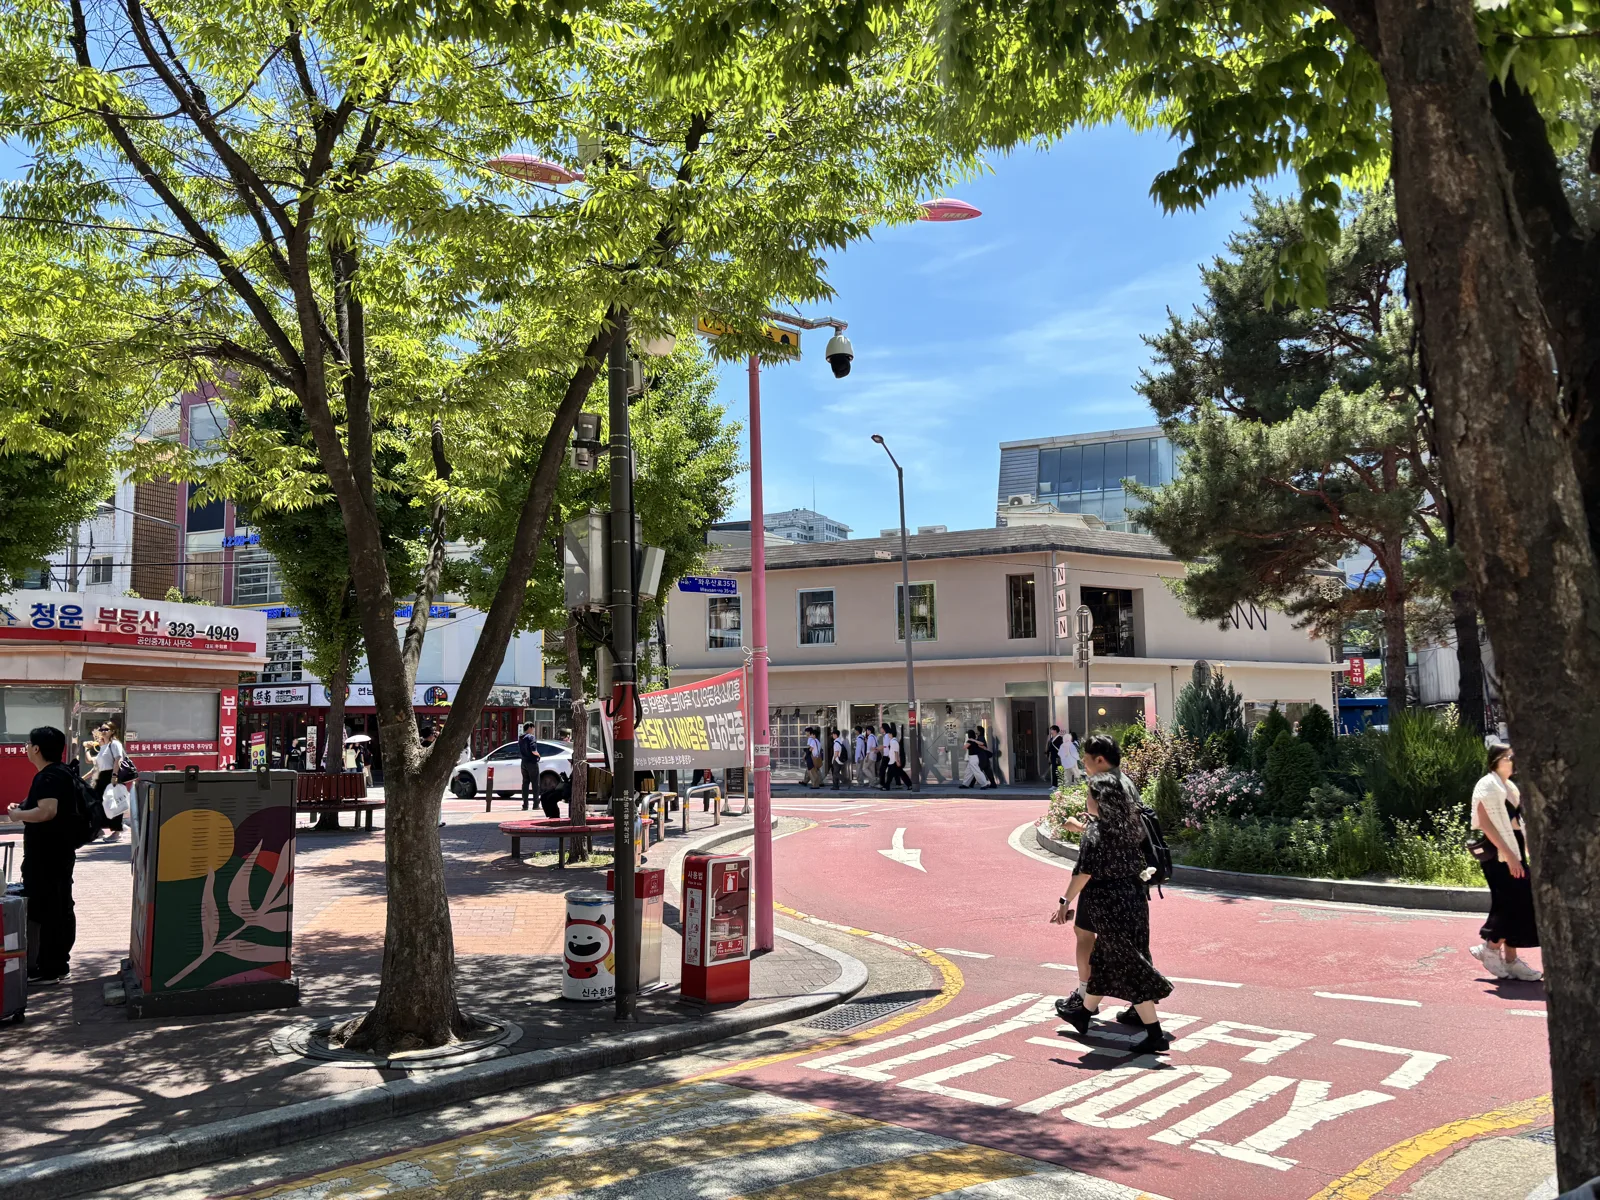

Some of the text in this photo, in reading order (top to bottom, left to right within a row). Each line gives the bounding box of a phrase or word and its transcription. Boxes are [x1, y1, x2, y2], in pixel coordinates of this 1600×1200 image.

[698, 578, 736, 588] 와우산로35길
[30, 602, 239, 641] 청운 부동산 323-4949
[137, 636, 171, 647] 공인중개사
[173, 639, 193, 648] 사무소
[687, 870, 703, 880] 사용법
